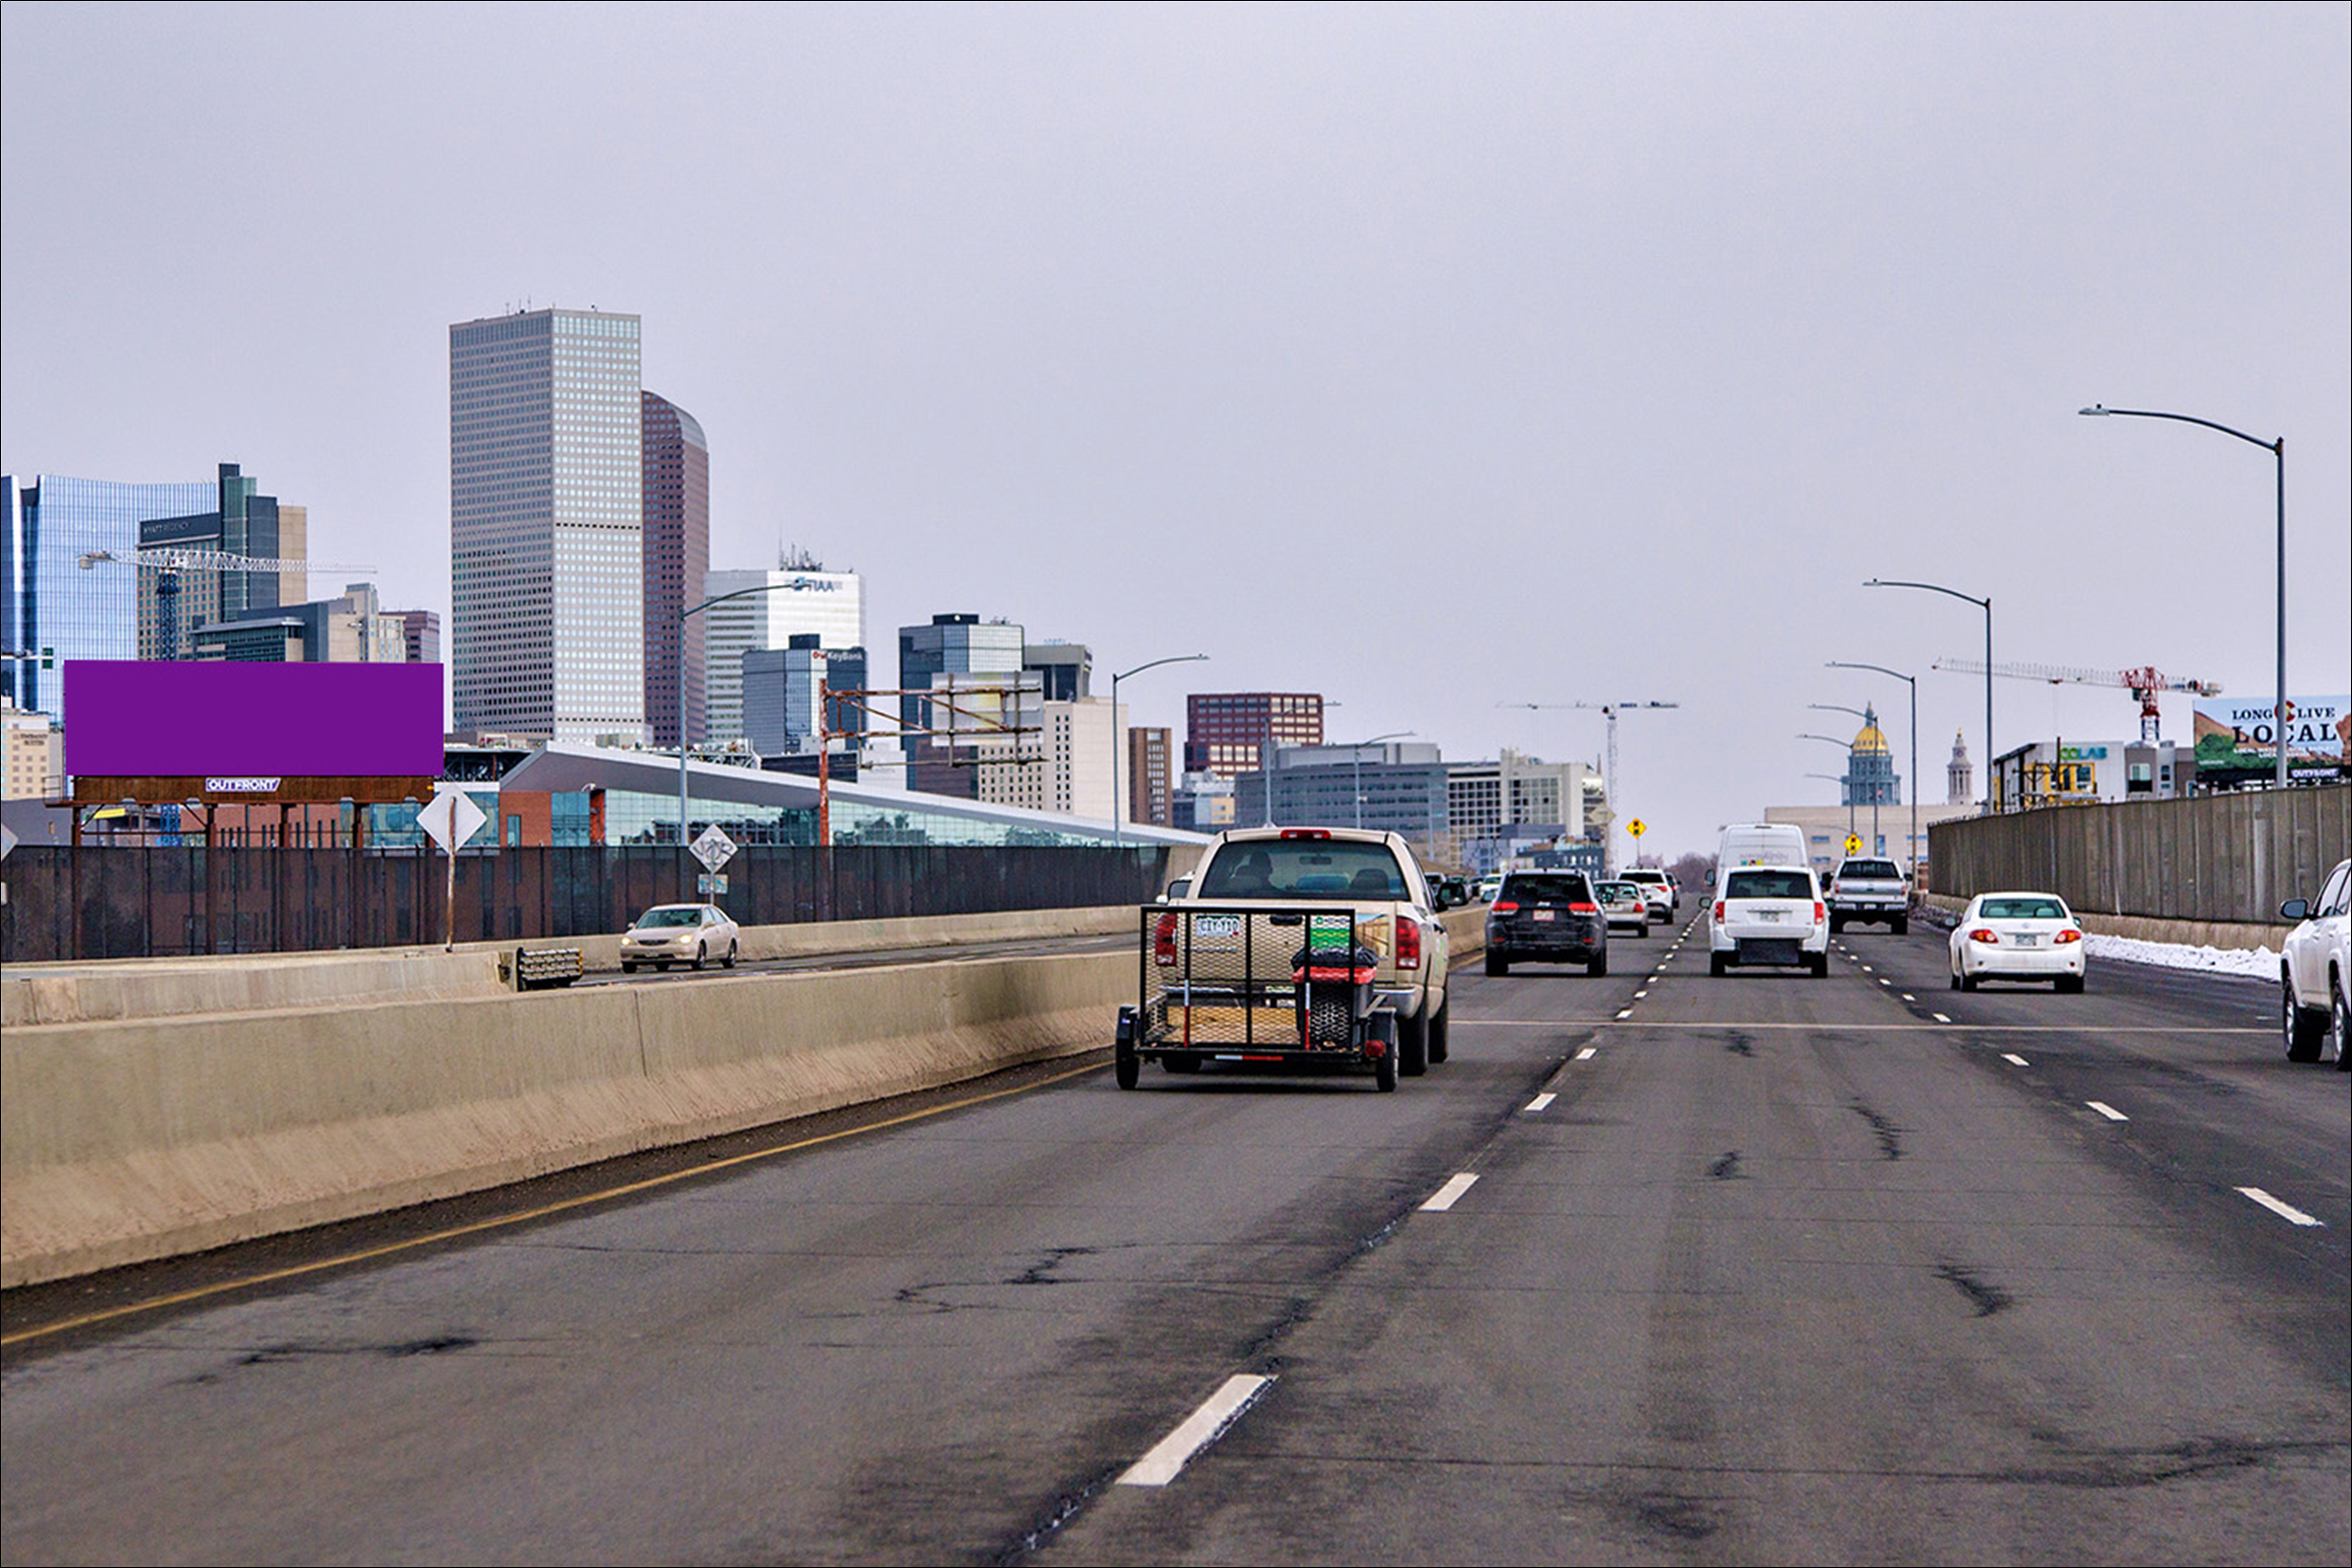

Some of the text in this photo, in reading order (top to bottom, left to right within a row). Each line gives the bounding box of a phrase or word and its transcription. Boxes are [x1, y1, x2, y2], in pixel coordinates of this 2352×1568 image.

[2231, 709, 2274, 720] LONG
[2297, 707, 2335, 718] LIVE
[207, 778, 280, 792] OUTFRONT
